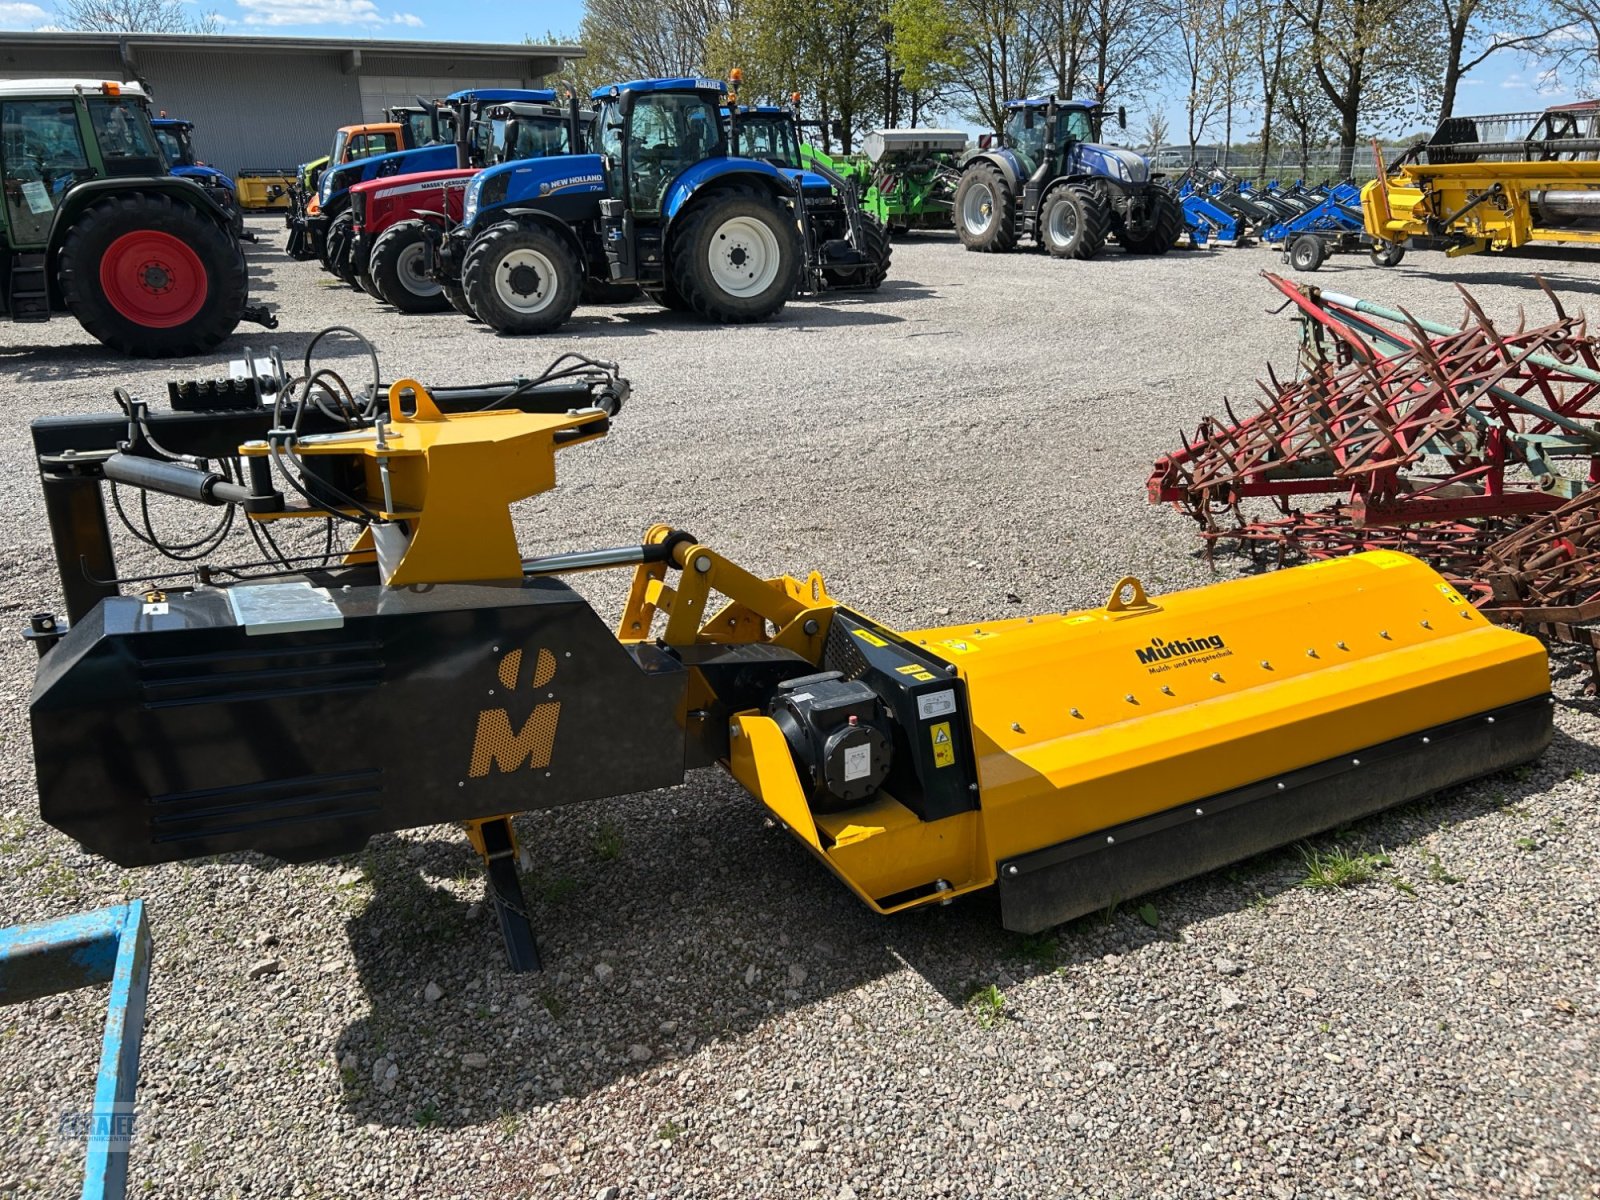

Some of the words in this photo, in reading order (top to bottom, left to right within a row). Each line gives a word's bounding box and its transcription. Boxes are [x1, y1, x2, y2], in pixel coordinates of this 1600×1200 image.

[551, 180, 568, 188] NEW
[569, 174, 602, 184] HOLLAND
[1135, 635, 1225, 664] Müthing
[1149, 665, 1172, 675] Mulch-
[1174, 660, 1187, 669] und
[1187, 649, 1234, 665] Pflegetechnik
